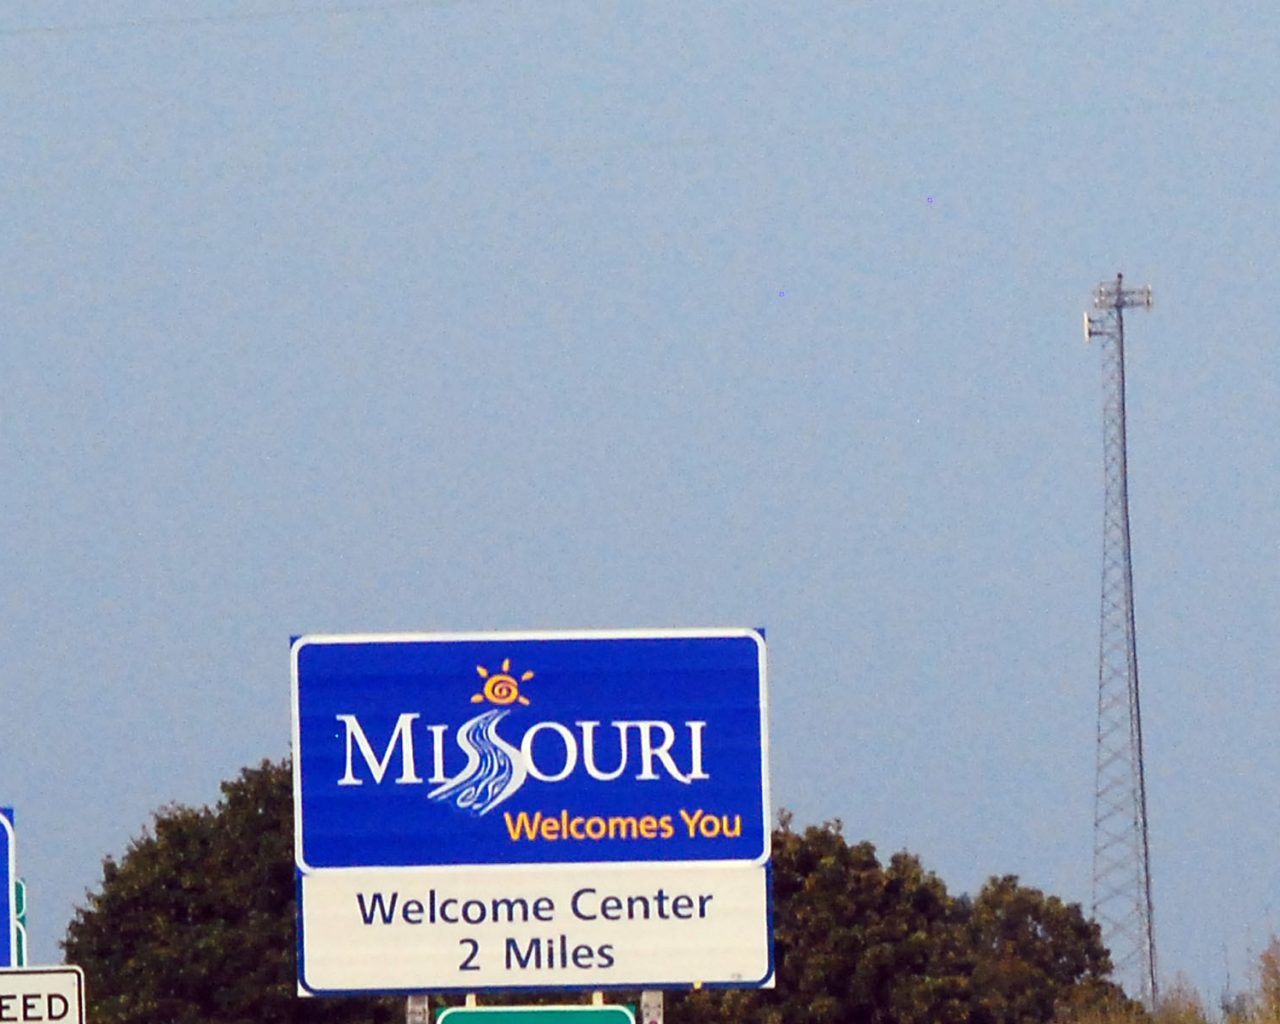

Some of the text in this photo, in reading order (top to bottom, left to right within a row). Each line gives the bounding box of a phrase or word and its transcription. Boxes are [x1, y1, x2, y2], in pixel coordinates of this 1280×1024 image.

[335, 709, 710, 816] MISSOURI
[504, 809, 742, 841] Welcomes You
[356, 888, 714, 925] Welcome Center
[458, 934, 616, 971] 2 Miles
